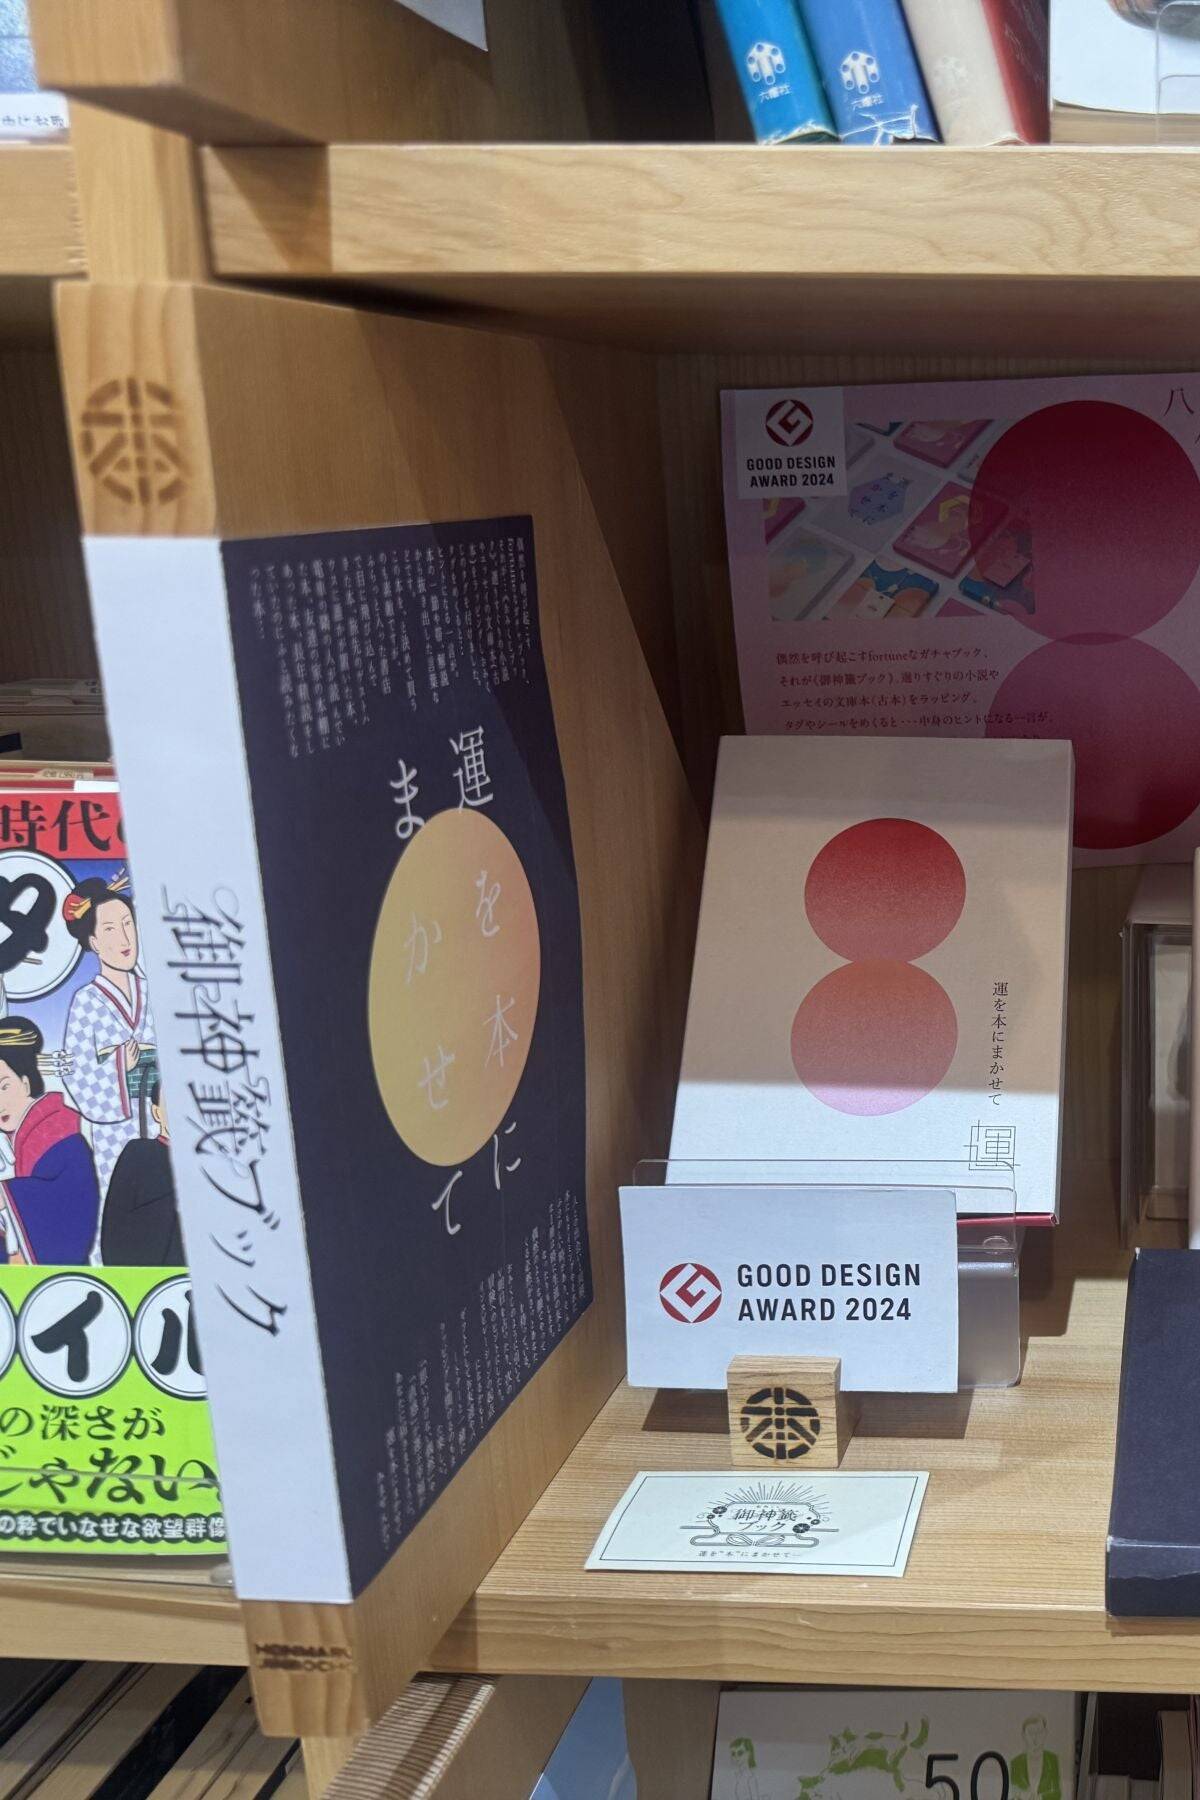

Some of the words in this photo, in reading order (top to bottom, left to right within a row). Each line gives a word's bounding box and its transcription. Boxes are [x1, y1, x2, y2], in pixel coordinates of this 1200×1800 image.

[746, 457, 783, 471] GOOD
[787, 455, 836, 470] DESIGN
[750, 475, 797, 489] AWARD
[802, 473, 834, 487] 2024
[0, 799, 127, 852] 時代
[388, 758, 465, 1235] まかせて
[987, 980, 1010, 1107] 運を本にまかせて
[161, 884, 289, 1338] 御神籤ブック
[736, 1262, 812, 1288] GOOD
[820, 1262, 922, 1287] DESIGN
[736, 1297, 836, 1322] AWARD
[845, 1296, 912, 1322] 2024
[0, 1404, 166, 1441] の深さが
[0, 1445, 221, 1505] ゃない
[733, 1508, 800, 1521] 御神籤
[738, 1520, 787, 1532] ブック
[925, 1750, 1013, 1800] 50
